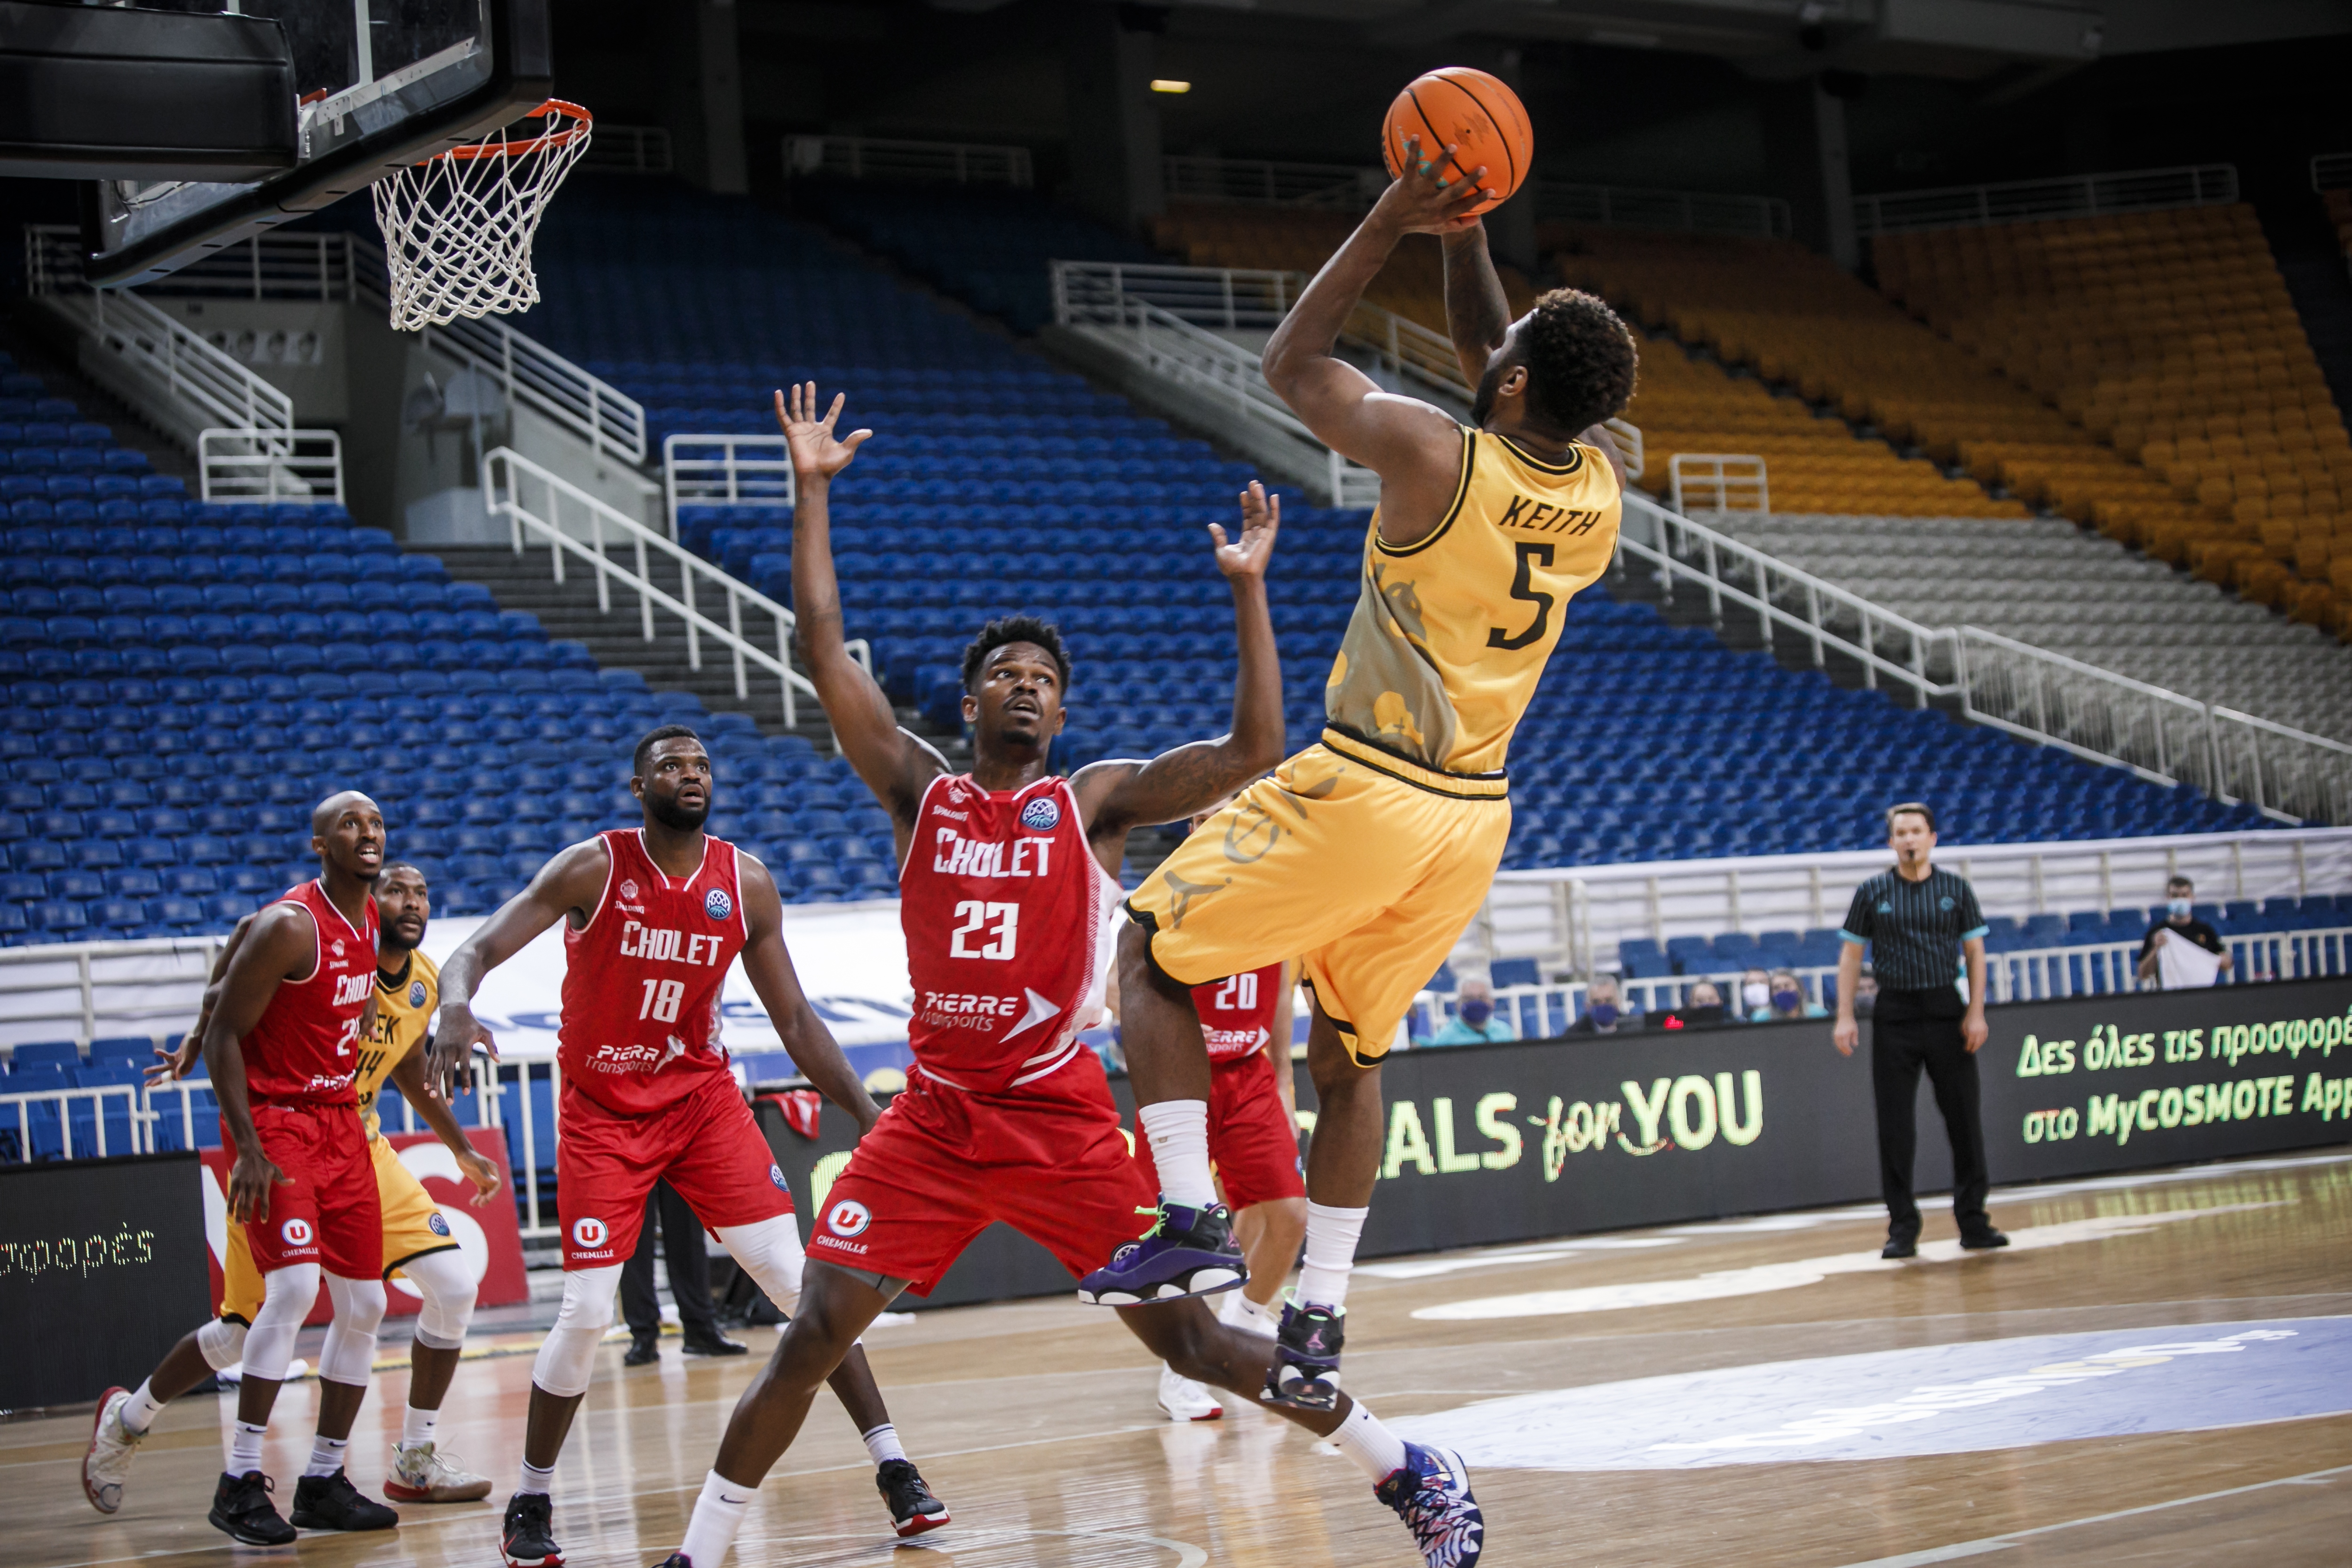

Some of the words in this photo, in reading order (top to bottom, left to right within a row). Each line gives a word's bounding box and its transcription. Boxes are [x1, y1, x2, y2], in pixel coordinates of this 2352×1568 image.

[1498, 495, 1602, 536] KEITH
[1486, 541, 1555, 651] 5
[933, 827, 1055, 878] CHOLET
[615, 900, 645, 914] SPALDING
[620, 920, 723, 966] CHOLET
[950, 900, 1019, 960] 23
[332, 970, 377, 1007] CHOLE
[639, 979, 685, 1023] 18
[1216, 973, 1258, 1010] 20
[586, 1054, 653, 1075] Transports
[2017, 1035, 2076, 1078] Δες
[2083, 1023, 2154, 1071] όλες
[2163, 1028, 2203, 1063] τις
[1294, 1091, 1524, 1186] ALS
[1527, 1095, 1622, 1183] for
[1621, 1070, 1763, 1152] YOU
[2022, 1106, 2078, 1144] στο
[2086, 1075, 2294, 1146] MyCOSMOTE
[289, 1226, 306, 1240] U
[581, 1226, 599, 1242] U
[837, 1209, 862, 1228] U
